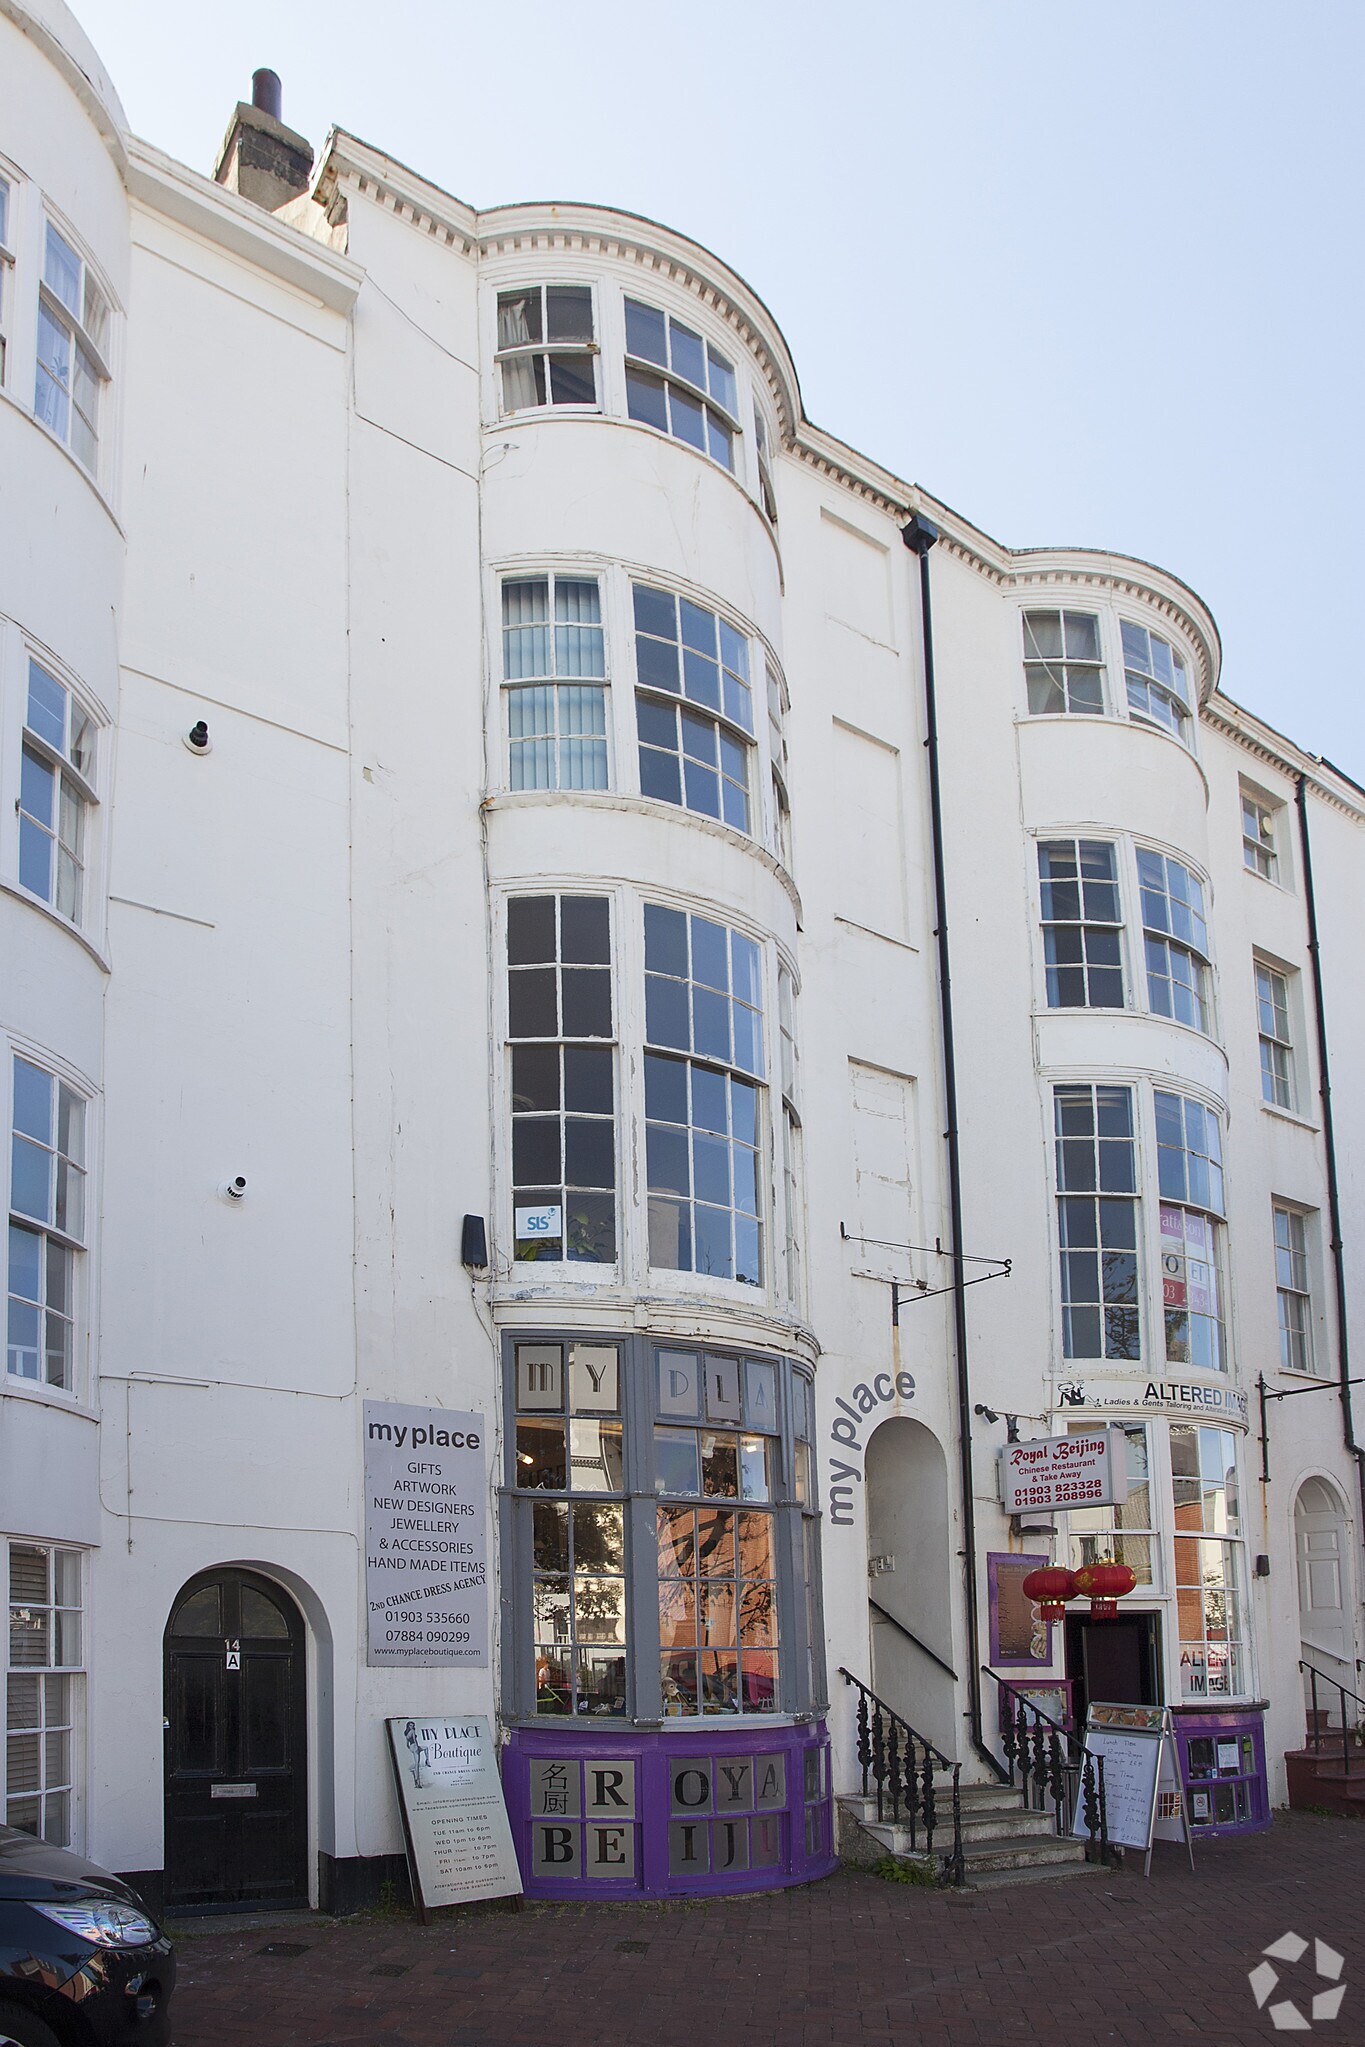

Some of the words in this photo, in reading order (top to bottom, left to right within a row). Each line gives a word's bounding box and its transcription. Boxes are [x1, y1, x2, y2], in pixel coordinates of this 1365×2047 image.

[527, 1216, 549, 1230] SIS
[1144, 1382, 1222, 1406] ALTERED
[830, 1371, 916, 1452] place
[1104, 1398, 1131, 1406] Ladies
[1133, 1398, 1139, 1406] &
[1142, 1399, 1164, 1407] Gents
[1166, 1400, 1192, 1411] Tailoring
[1010, 1446, 1048, 1466] Royal
[1052, 1438, 1104, 1460] Beijing
[407, 1462, 442, 1476] GIFTS
[1018, 1465, 1050, 1475] Chinese
[1052, 1458, 1096, 1471] Restaurant
[1040, 1474, 1058, 1482] Take
[1060, 1471, 1082, 1480] Away
[393, 1480, 457, 1496] ARTWORK
[829, 1458, 862, 1526] my
[1014, 1486, 1052, 1497] 01903
[1054, 1480, 1102, 1492] 823328
[1015, 1495, 1052, 1506] 01903
[1056, 1489, 1102, 1502] 208996
[374, 1497, 404, 1510] NEW
[407, 1500, 475, 1516] DESIGNERS
[390, 1518, 460, 1533] JEWELLERY
[379, 1538, 388, 1550] &
[392, 1538, 474, 1554] ACCESSORIES
[368, 1556, 406, 1570] HAND
[410, 1558, 447, 1572] MADE
[450, 1561, 486, 1574] ITEMS
[386, 1589, 422, 1606] CHANCE
[424, 1582, 452, 1598] DRESS
[453, 1574, 487, 1591] AGENCY
[385, 1610, 422, 1622] 01903
[426, 1612, 470, 1624] 535660
[386, 1630, 423, 1642] 07884
[426, 1631, 470, 1642] 090299
[224, 1638, 240, 1652] 14
[374, 1647, 480, 1657] www.myplaceboutique.com
[228, 1654, 238, 1668] A
[420, 1728, 438, 1740] MY
[444, 1726, 482, 1740] PLACE
[428, 1742, 482, 1764] Boutique
[431, 1817, 464, 1826] OPENING
[466, 1814, 488, 1822] TIMES
[434, 1848, 452, 1856] THUR
[434, 1882, 463, 1890] Alterations
